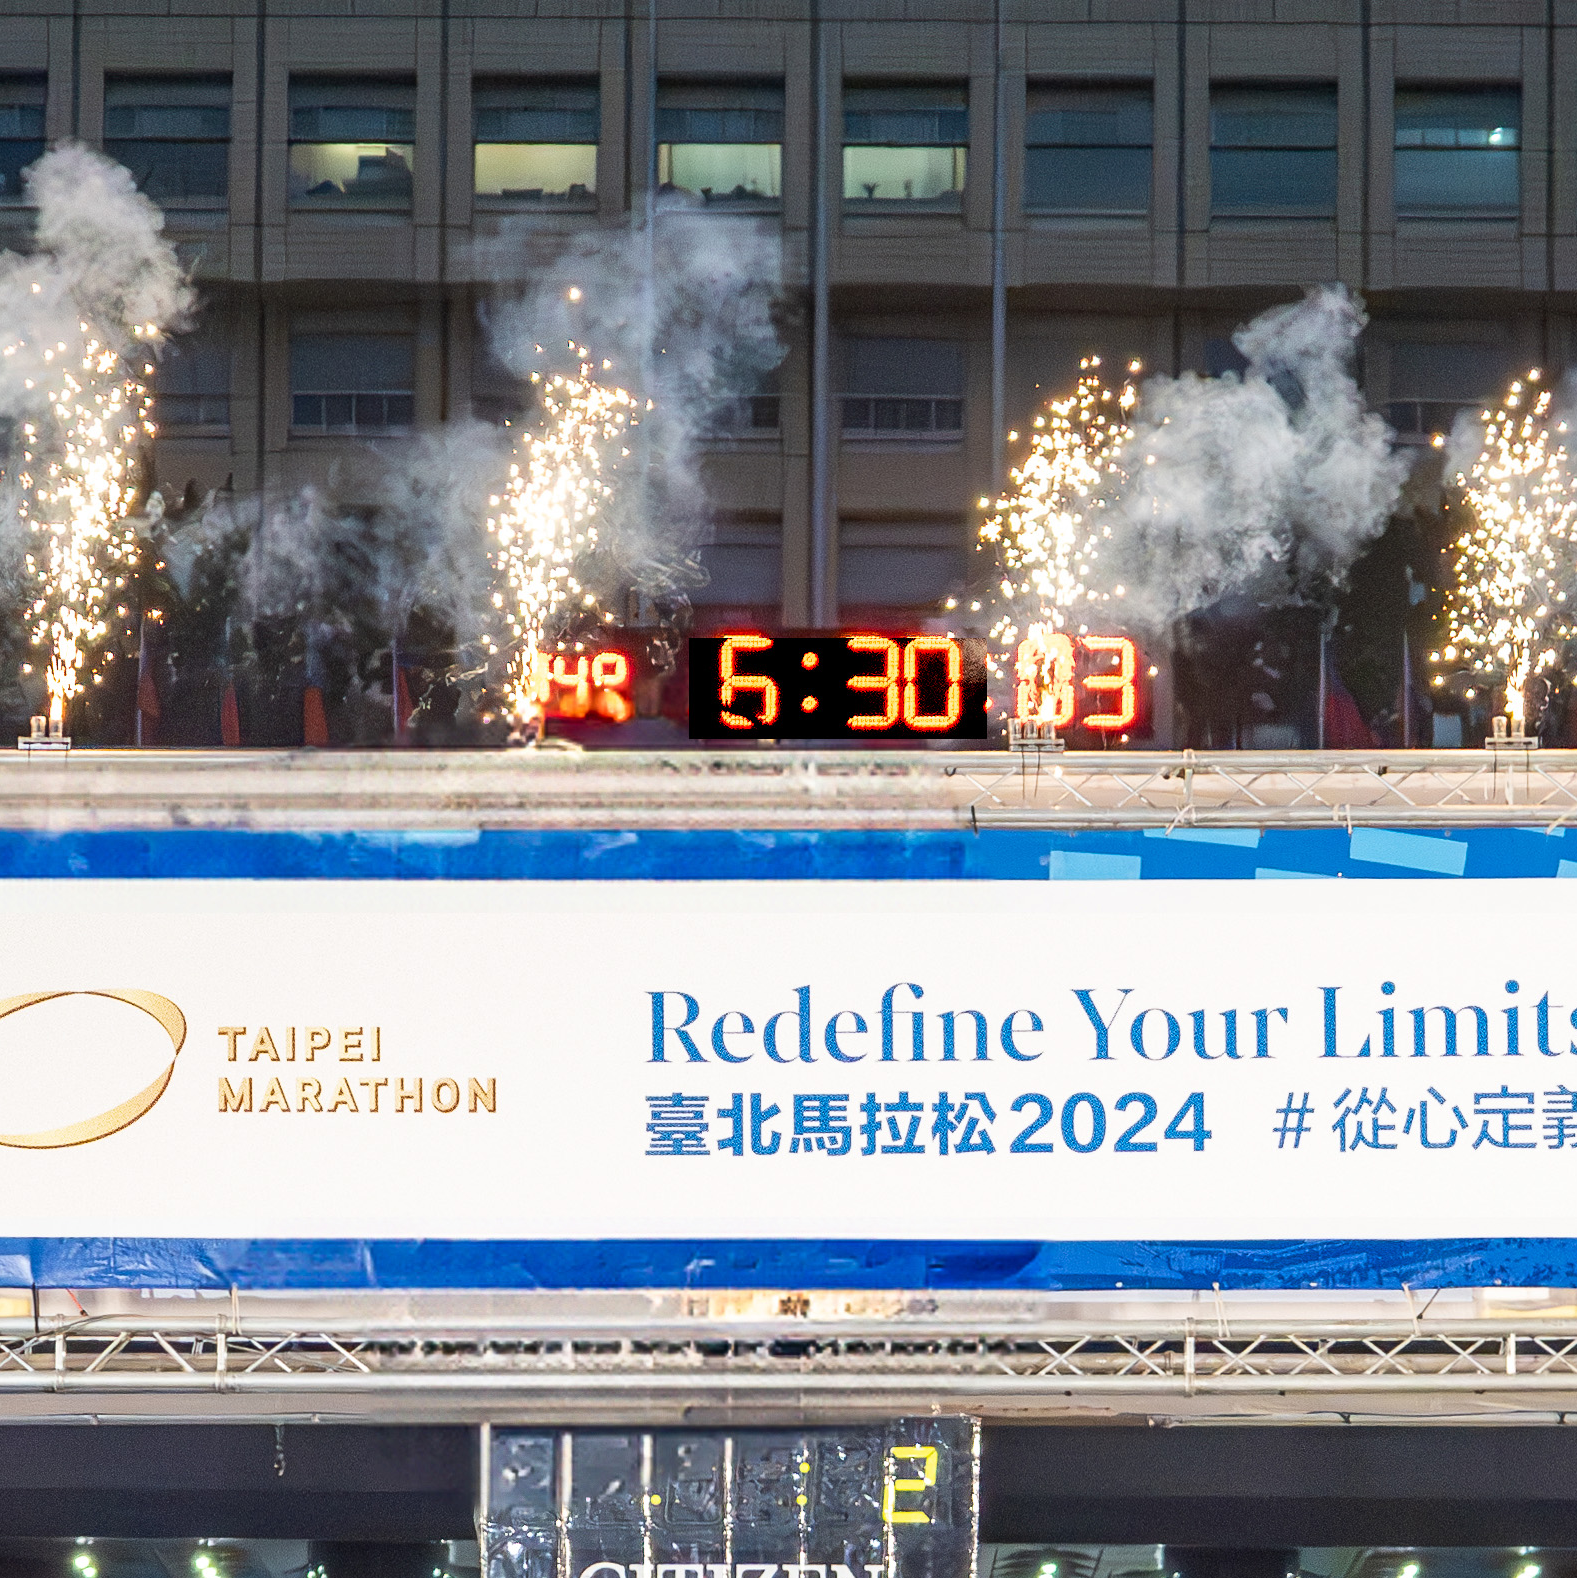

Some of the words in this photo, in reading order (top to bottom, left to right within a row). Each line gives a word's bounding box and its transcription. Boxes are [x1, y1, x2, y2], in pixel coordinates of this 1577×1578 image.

[217, 1024, 382, 1063] TAIPEI
[645, 981, 1044, 1064] Redefine
[1070, 986, 1289, 1062] Your
[217, 1077, 498, 1114] MARATHON
[644, 1090, 1213, 1157] 臺北馬拉松2024
